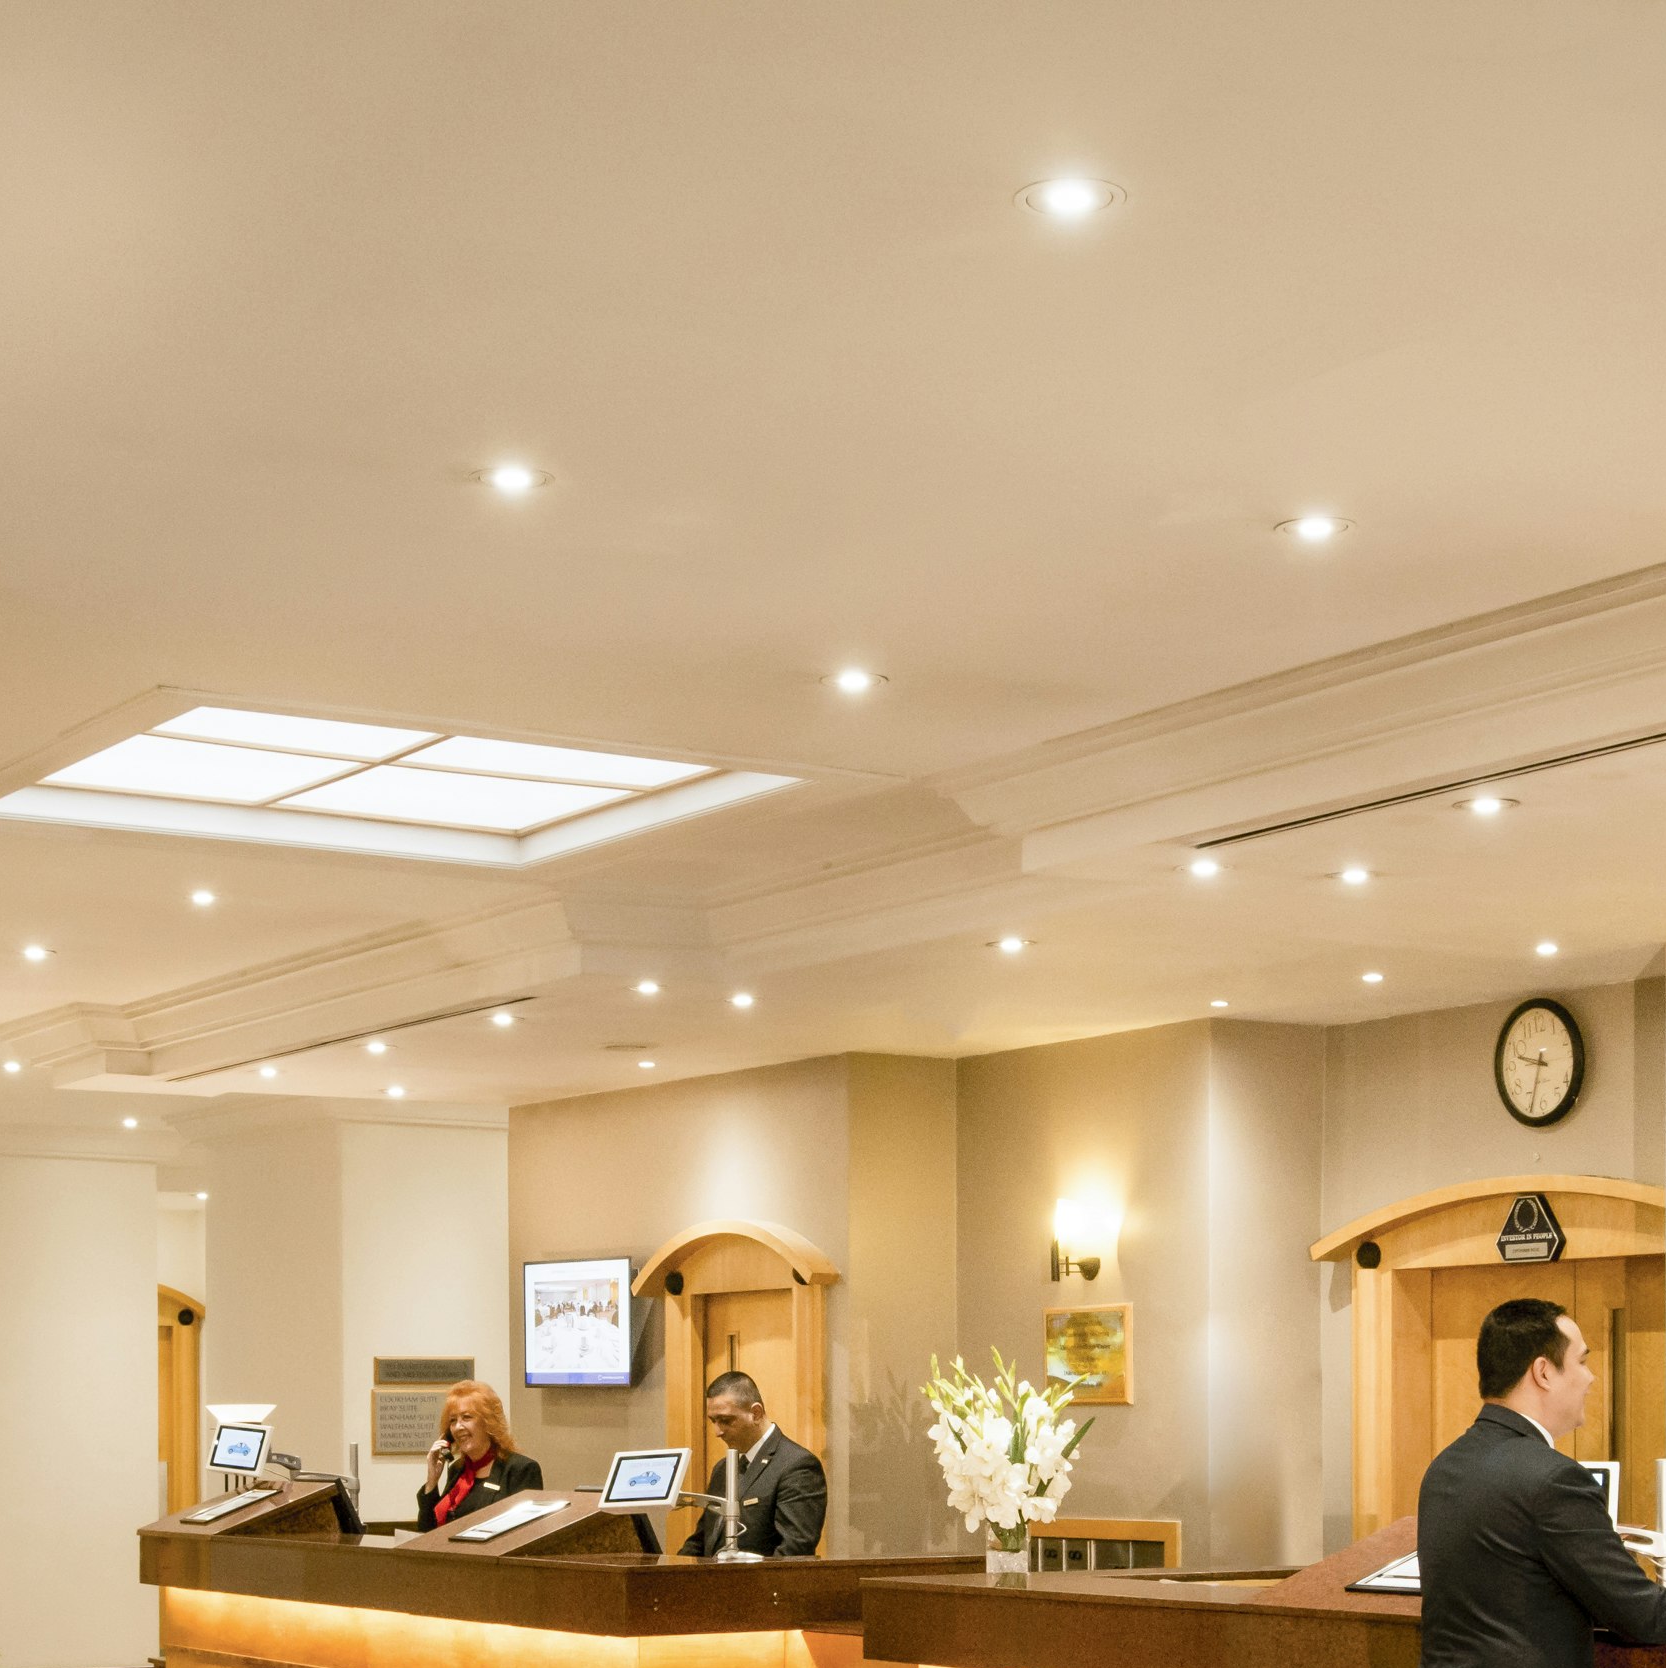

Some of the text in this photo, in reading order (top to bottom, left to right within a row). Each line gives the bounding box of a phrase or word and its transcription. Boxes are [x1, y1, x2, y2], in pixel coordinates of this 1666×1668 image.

[1523, 1022, 1532, 1039] 11
[1534, 1014, 1546, 1033] 12
[1513, 1039, 1527, 1058] 10
[1513, 1078, 1523, 1096] 8
[1562, 1071, 1570, 1088] 4
[1540, 1095, 1548, 1111] 6
